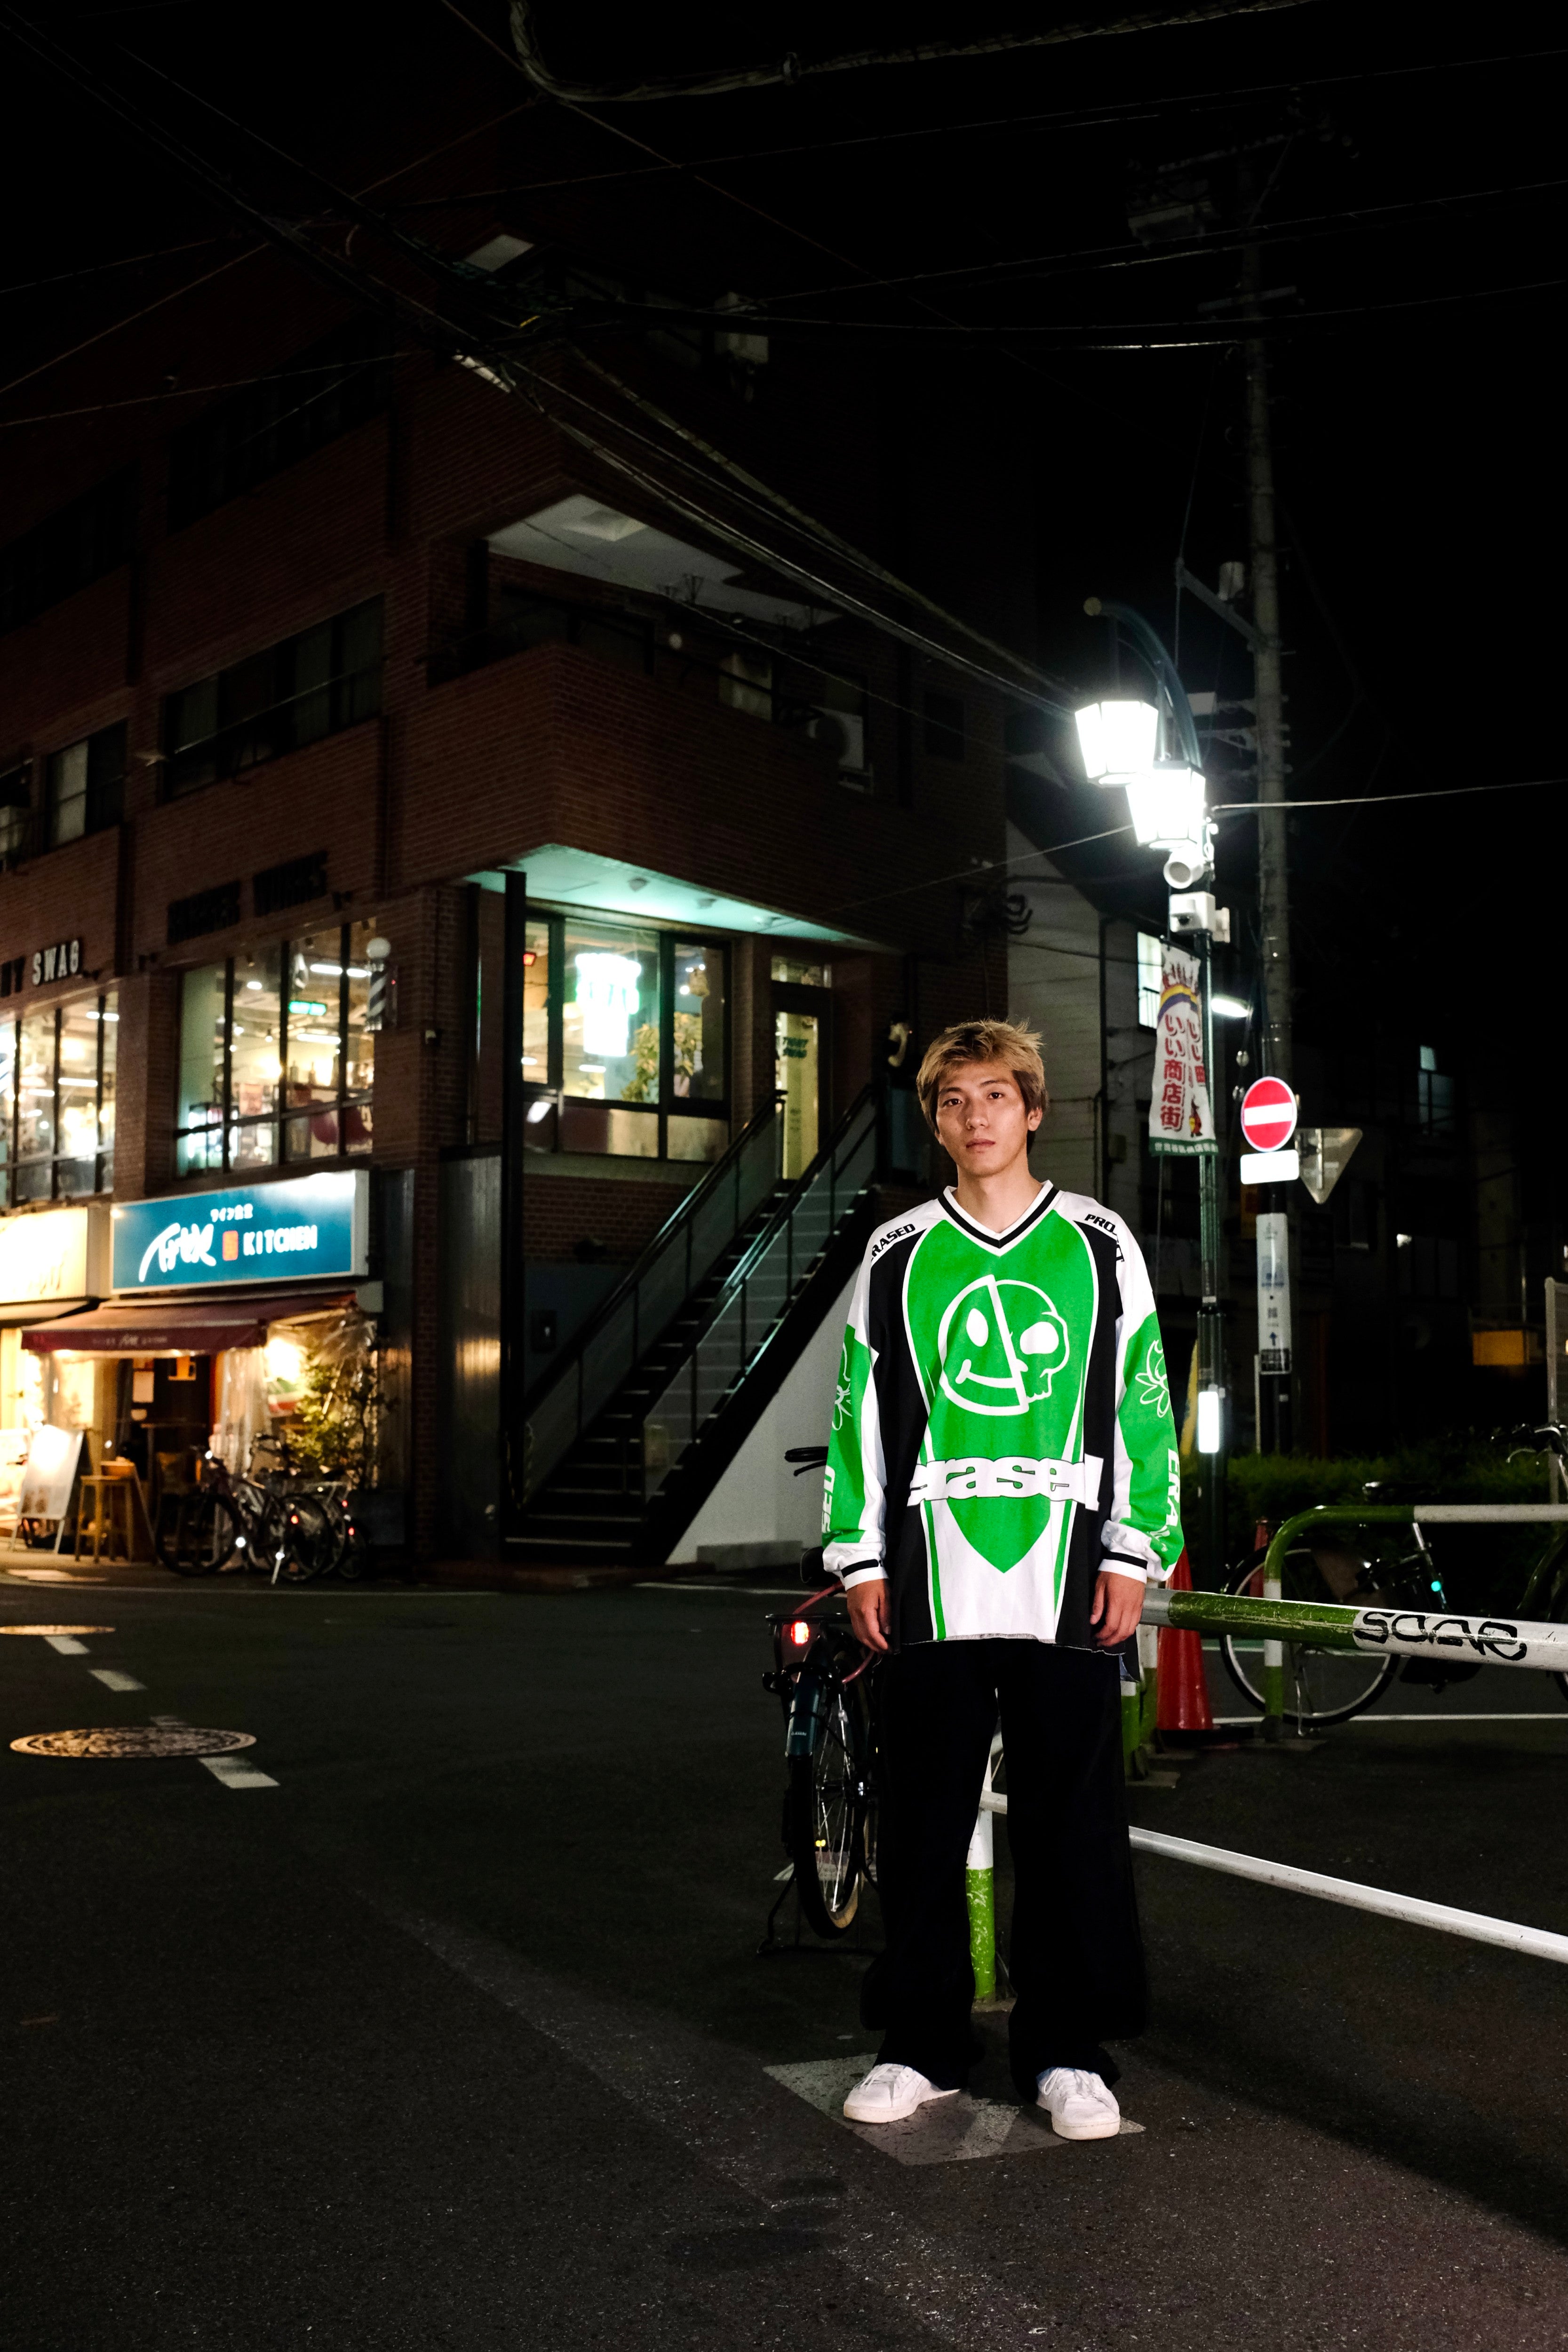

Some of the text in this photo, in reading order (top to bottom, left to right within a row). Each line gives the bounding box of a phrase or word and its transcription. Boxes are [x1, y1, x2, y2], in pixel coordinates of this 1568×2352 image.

[1160, 1014, 1185, 1132] いい商店街
[243, 1224, 318, 1256] KITCHEN
[871, 1224, 915, 1262] RASED
